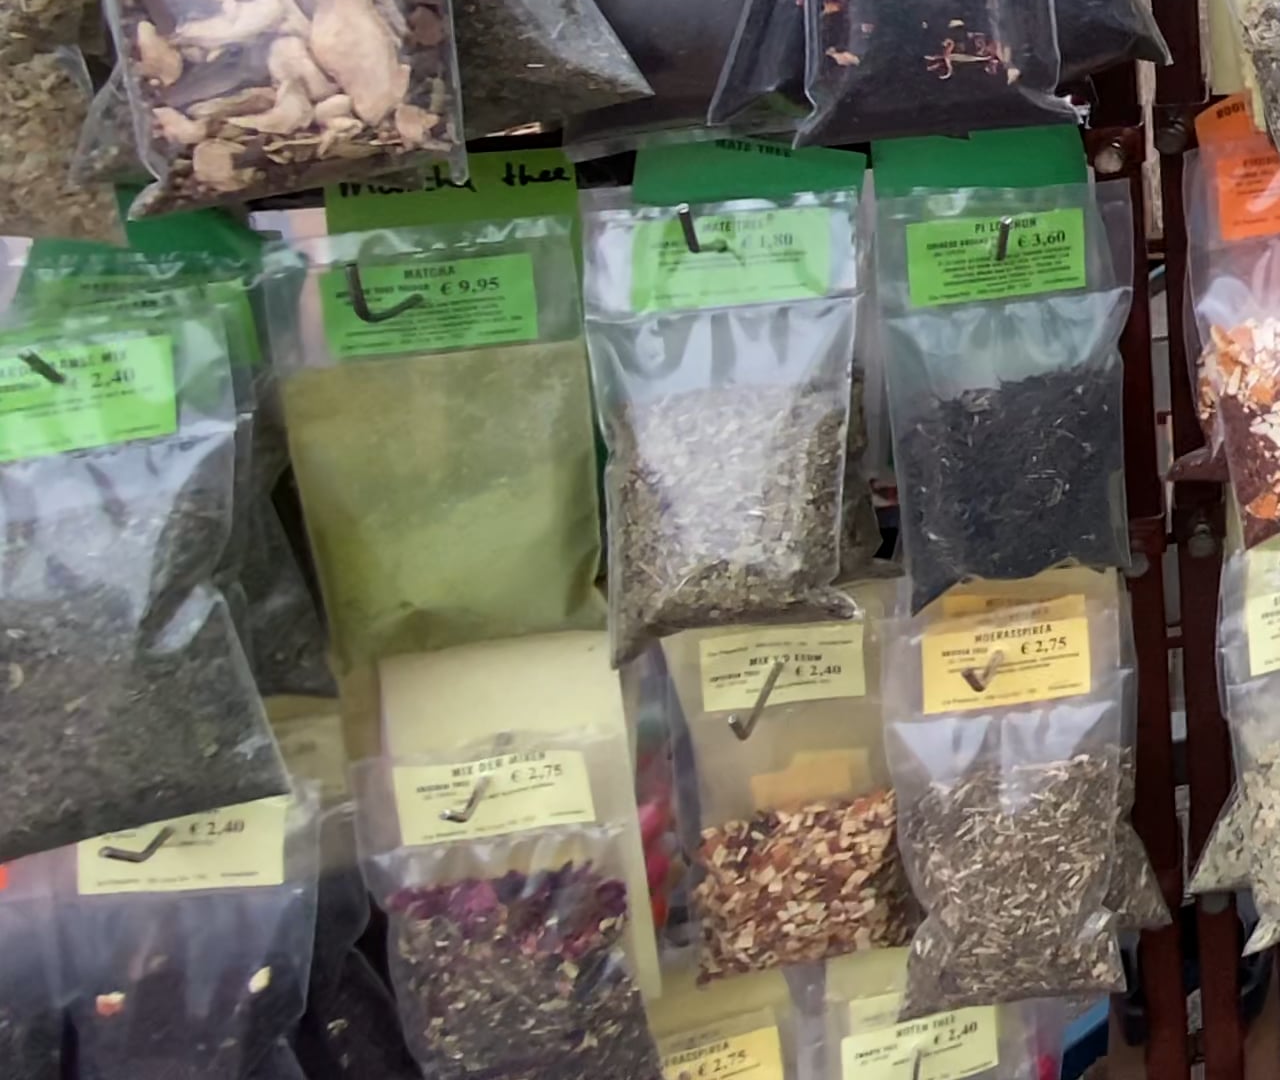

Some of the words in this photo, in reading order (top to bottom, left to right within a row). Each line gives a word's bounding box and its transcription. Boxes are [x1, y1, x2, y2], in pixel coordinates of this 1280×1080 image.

[715, 139, 750, 152] MATE
[503, 162, 571, 186] thee
[975, 223, 985, 233] PI
[1018, 236, 1028, 247] €
[1032, 230, 1065, 247] 3,60
[404, 266, 455, 279] MATCHA
[440, 283, 452, 295] €
[974, 624, 1052, 644] MOERASSPIREA
[1020, 642, 1030, 655] €
[1035, 636, 1067, 653] 2,75
[795, 665, 804, 676] €
[511, 769, 522, 782] €
[528, 765, 563, 782] 2,75
